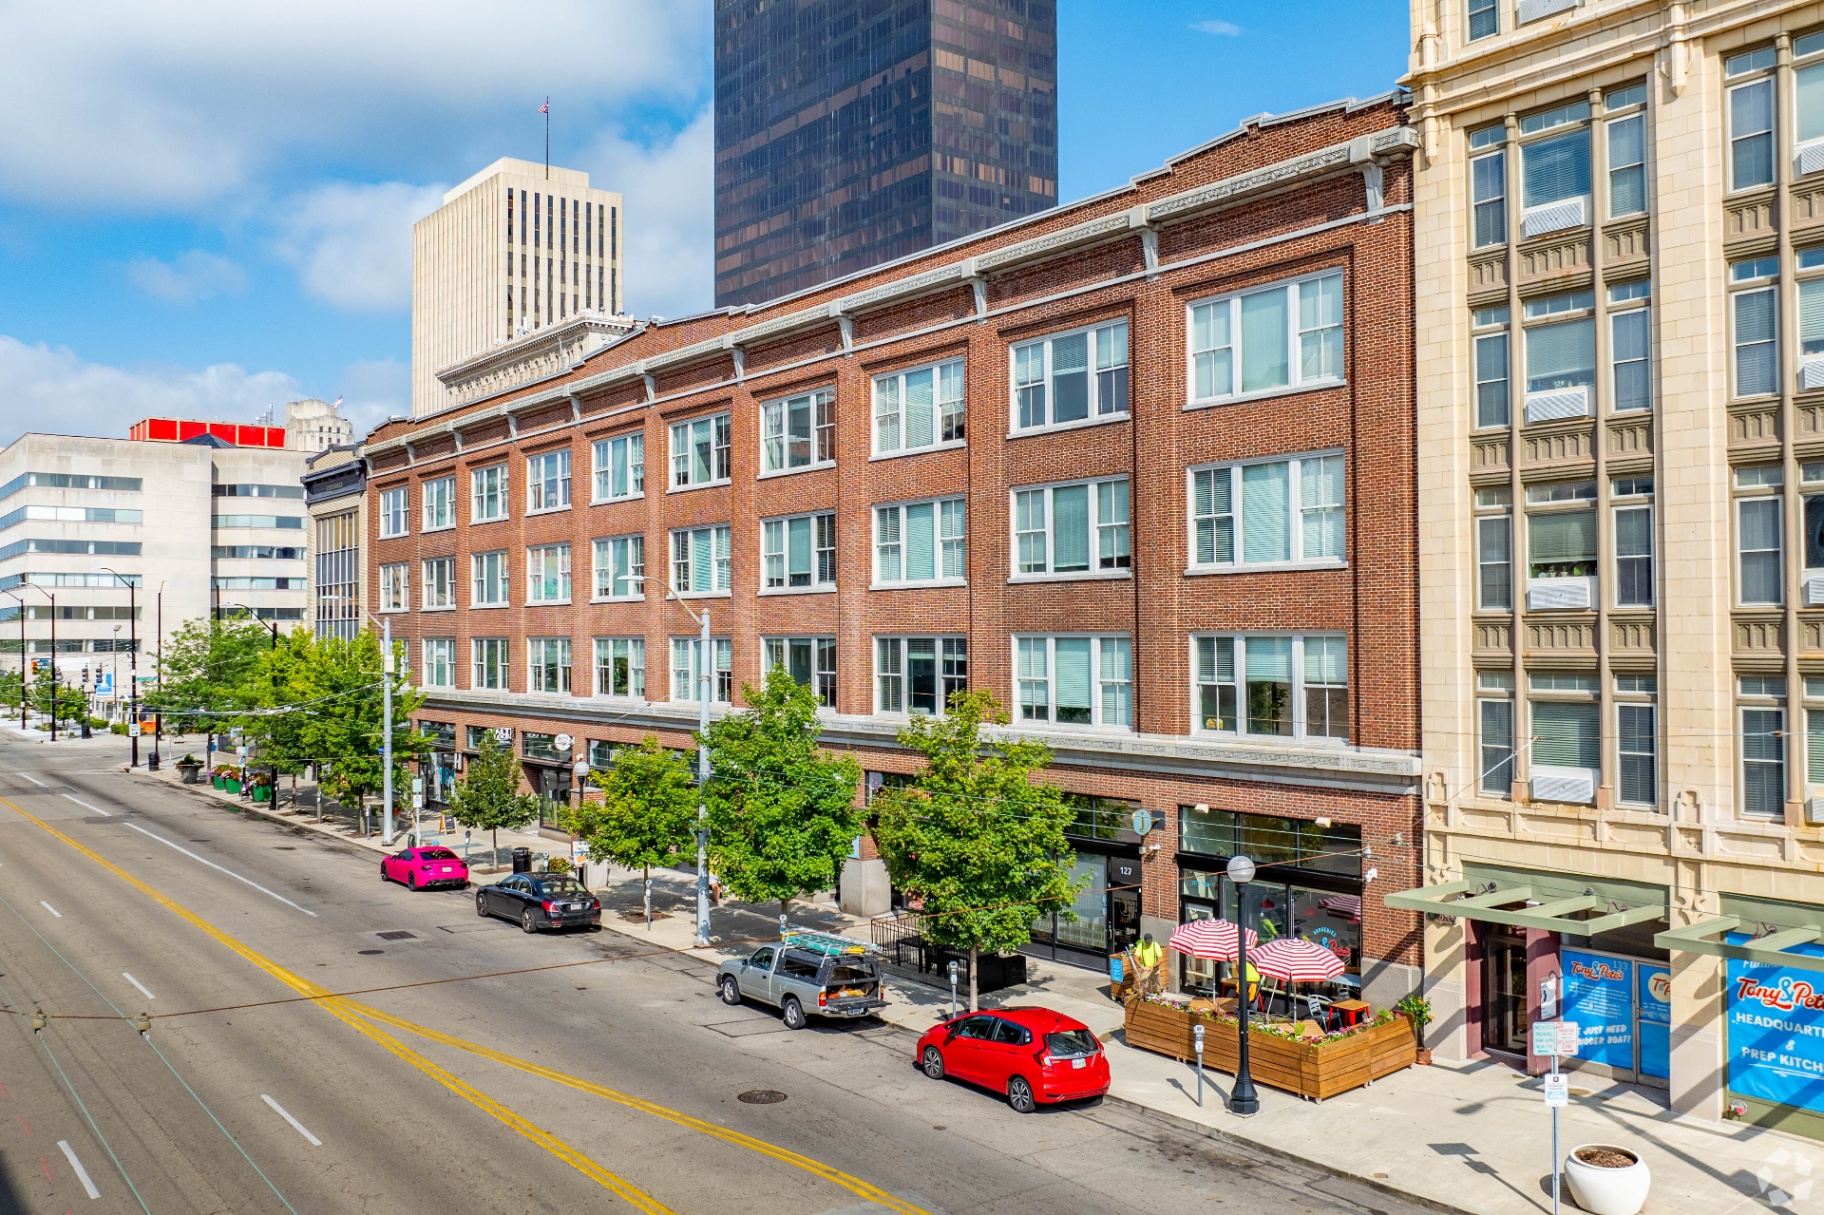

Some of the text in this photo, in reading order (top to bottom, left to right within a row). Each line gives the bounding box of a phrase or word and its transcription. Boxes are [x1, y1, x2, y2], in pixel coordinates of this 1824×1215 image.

[1120, 866, 1132, 875] 127
[1613, 960, 1628, 970] 133
[1571, 961, 1600, 981] Tony
[1598, 963, 1624, 981] Pete's
[1736, 976, 1824, 1012] Tony & Pet
[1583, 1025, 1604, 1035] JUST
[1606, 1024, 1627, 1034] NEED
[1607, 1035, 1631, 1044] BOAT!
[1785, 1039, 1795, 1051] &
[1741, 1046, 1776, 1062] PREP
